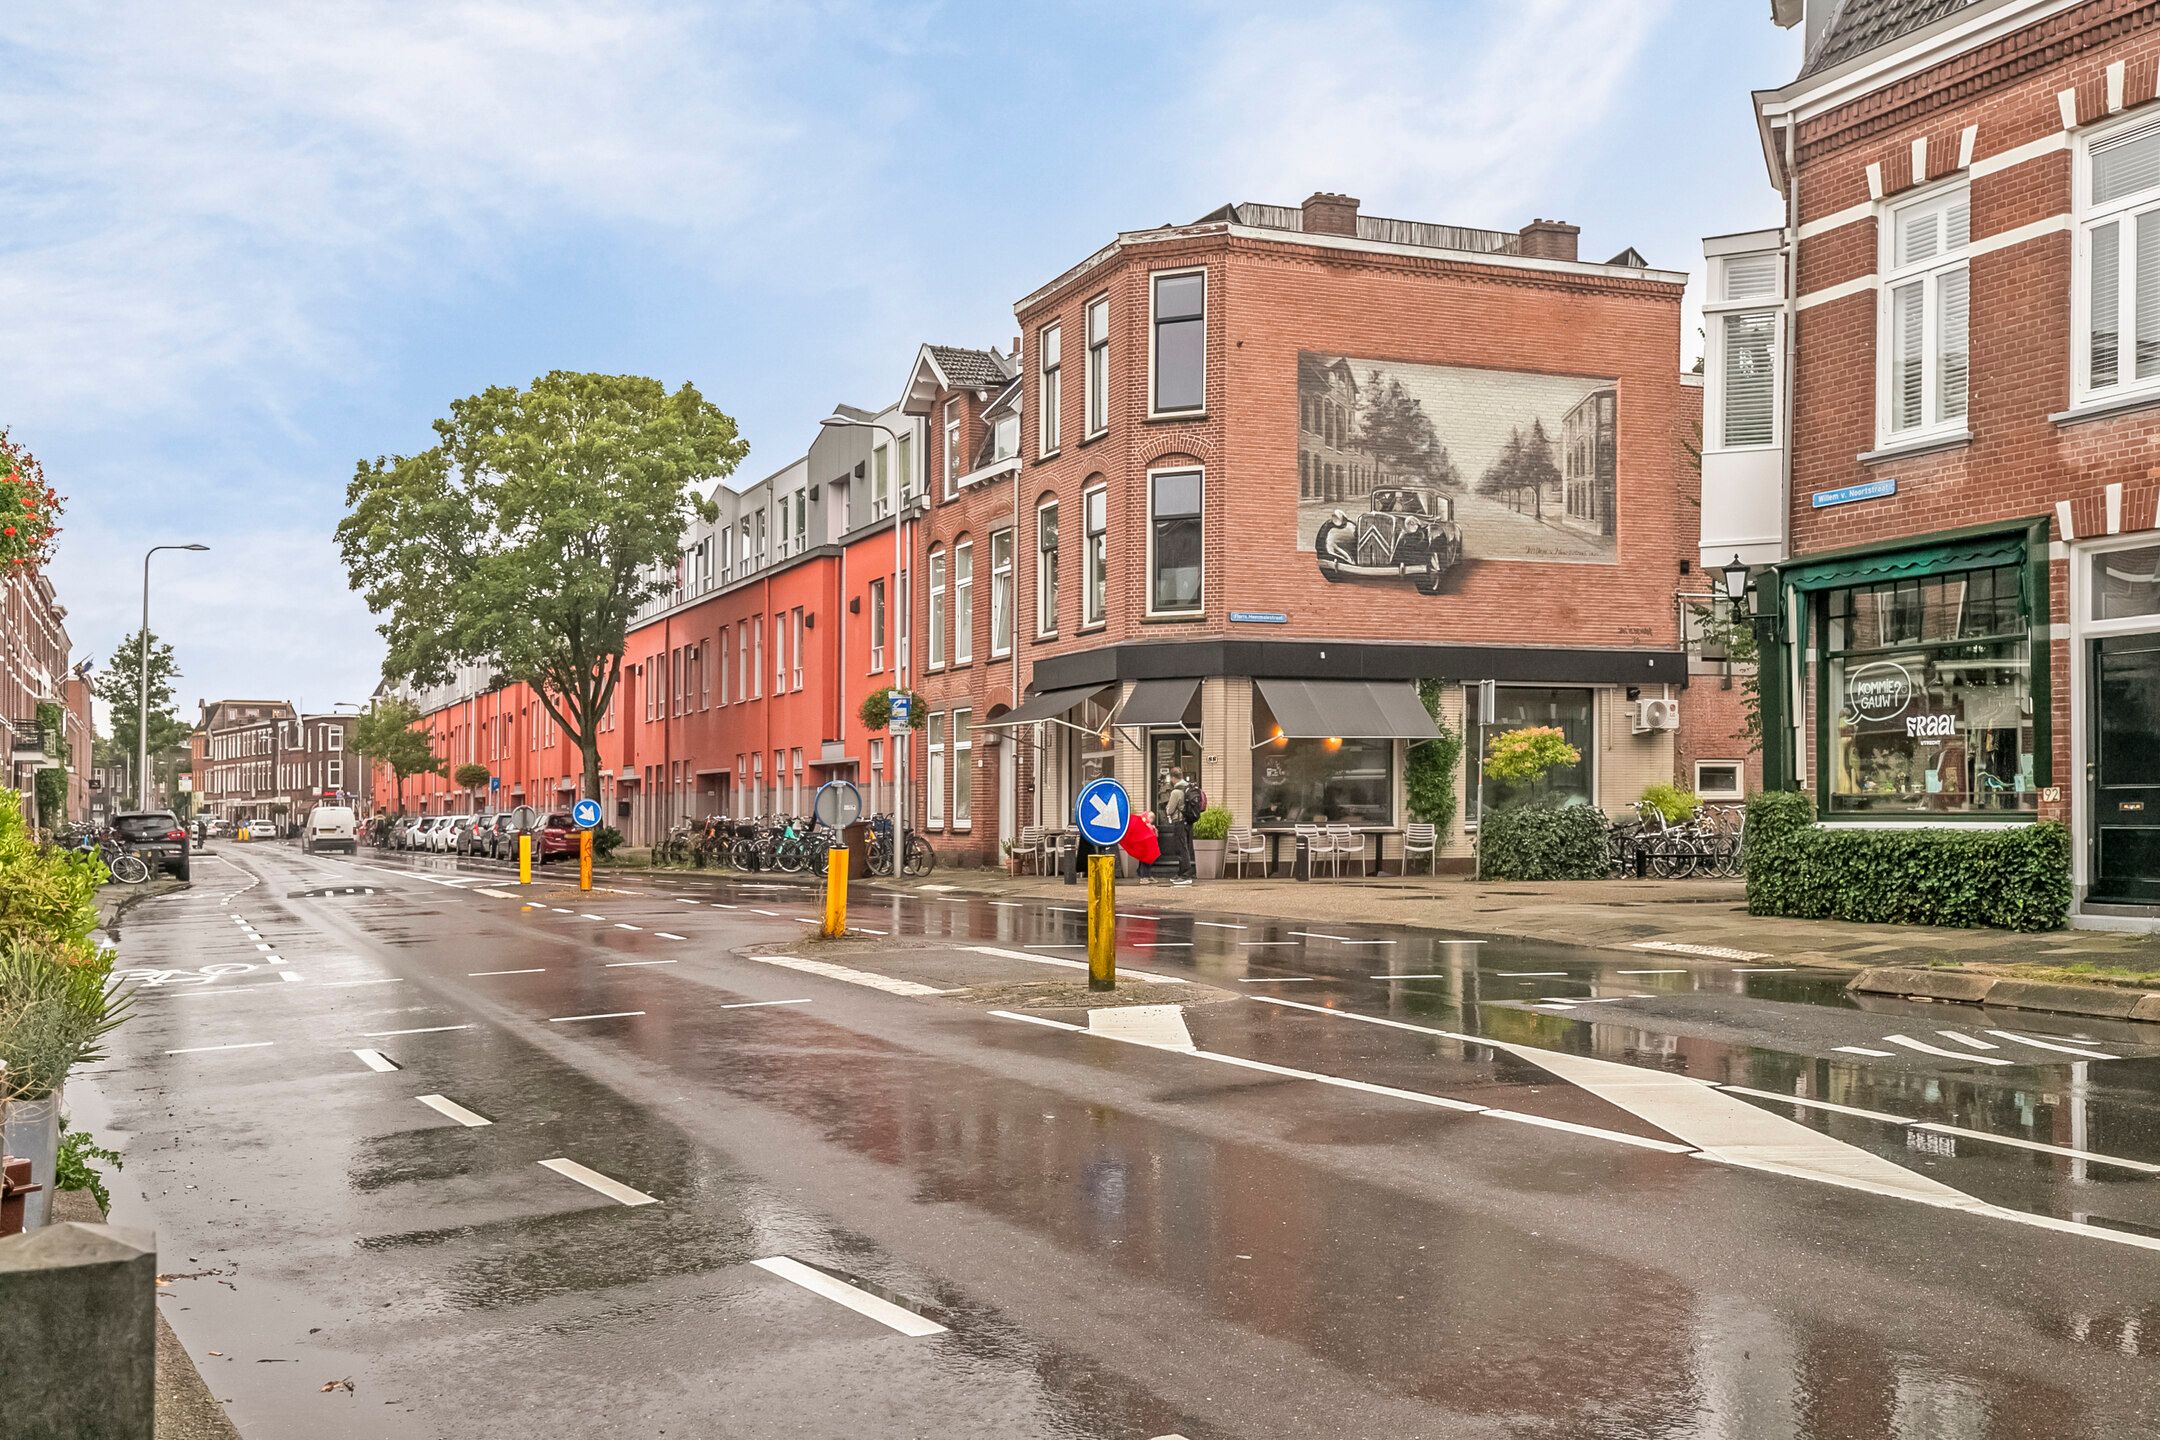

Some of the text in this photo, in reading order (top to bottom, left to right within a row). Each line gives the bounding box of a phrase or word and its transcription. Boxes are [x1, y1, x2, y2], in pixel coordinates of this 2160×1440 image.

[1818, 493, 1839, 503] Willem
[1849, 484, 1889, 497] Noortstraat
[1906, 714, 1956, 737] FRAAI
[2045, 788, 2059, 801] 92
